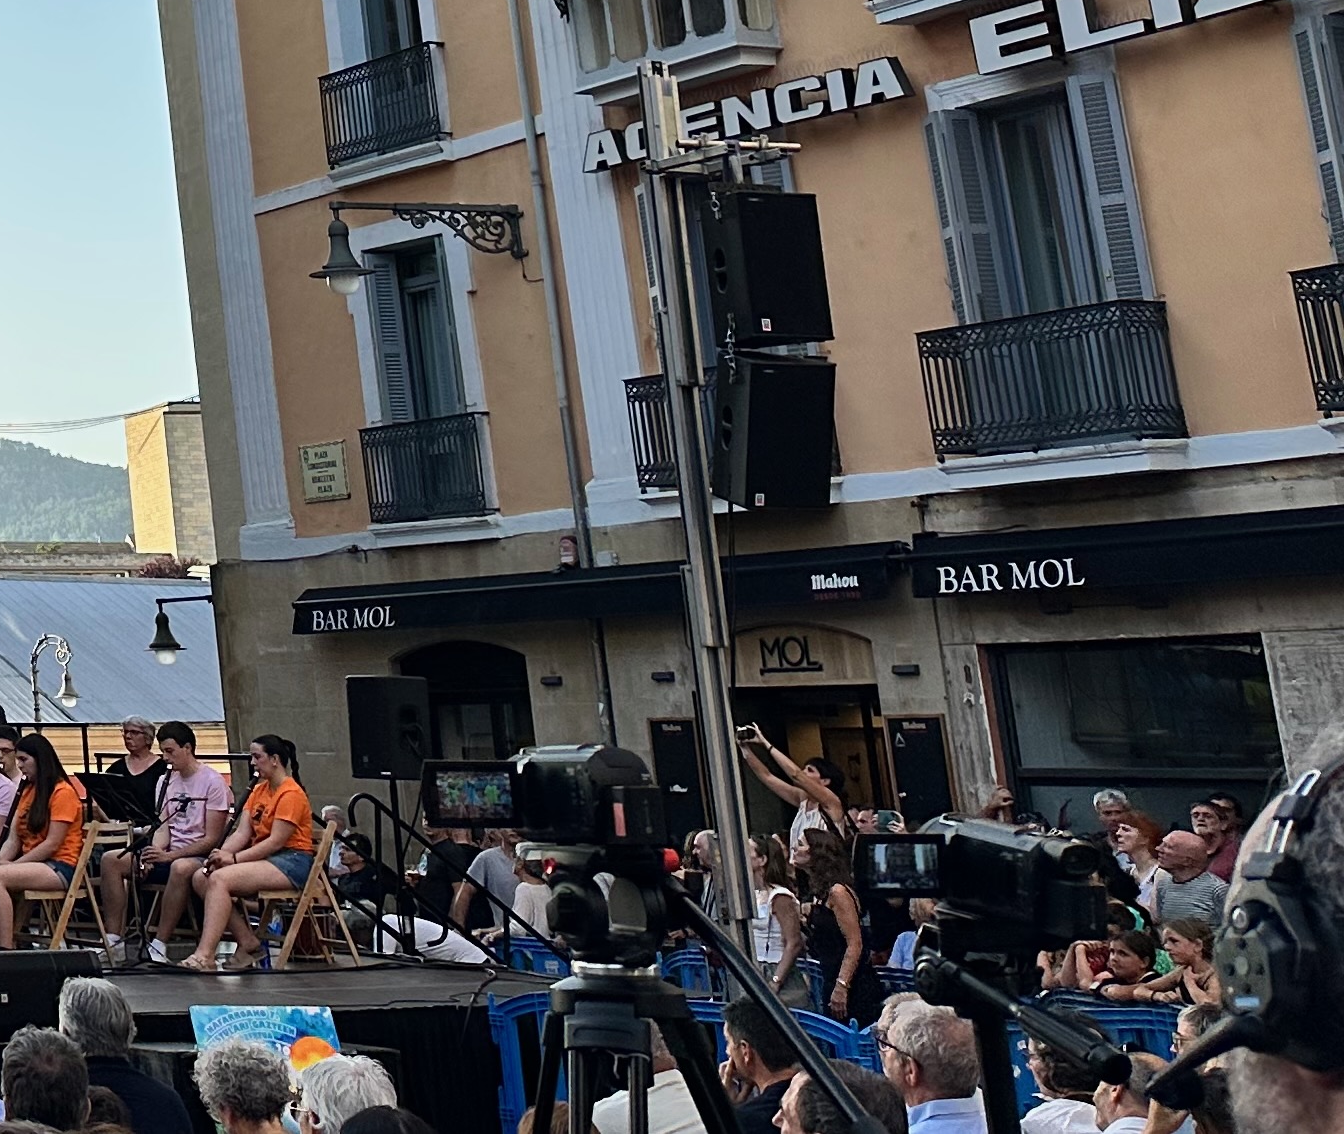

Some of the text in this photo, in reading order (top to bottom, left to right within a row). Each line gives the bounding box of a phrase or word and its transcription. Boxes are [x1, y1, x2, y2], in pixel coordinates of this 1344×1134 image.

[810, 572, 859, 590] Mahou
[936, 557, 1086, 594] BAR MOL
[312, 605, 395, 631] BAR MOL
[759, 635, 820, 668] MOL
